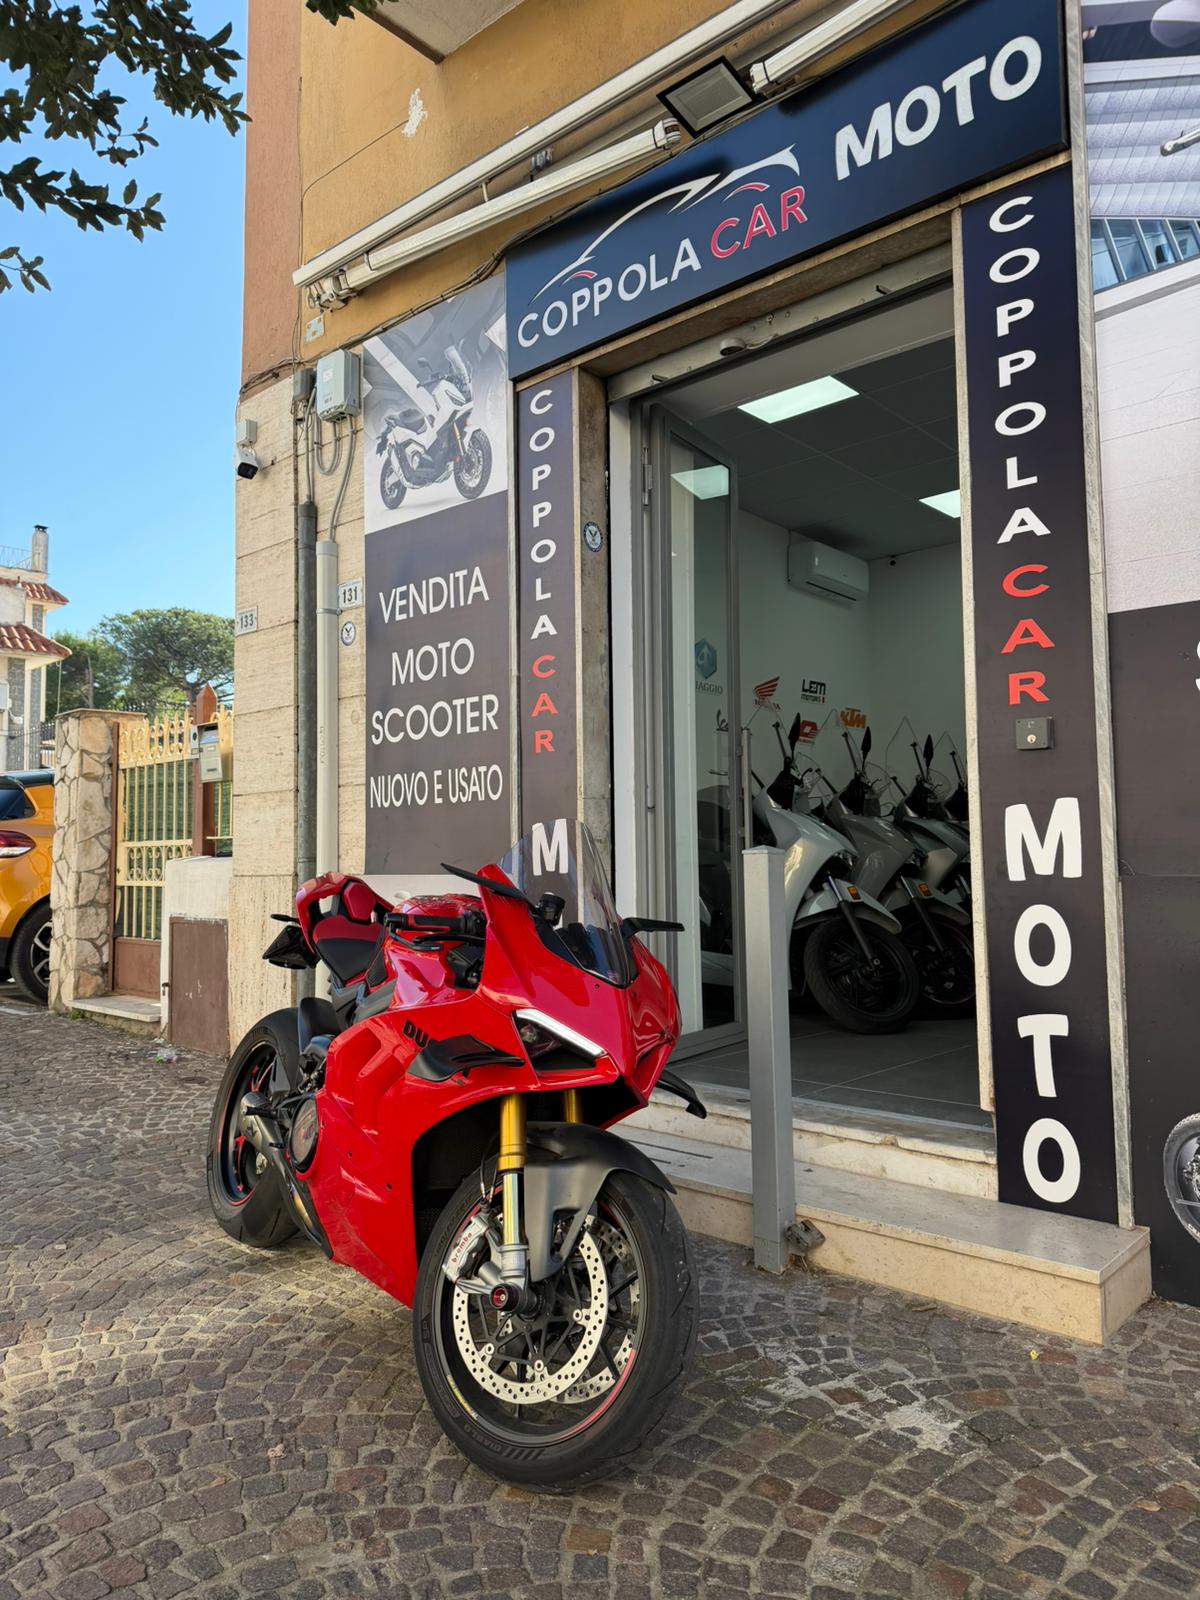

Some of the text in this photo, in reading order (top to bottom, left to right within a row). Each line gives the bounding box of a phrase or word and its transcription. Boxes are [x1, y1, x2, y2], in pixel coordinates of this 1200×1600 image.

[835, 35, 1042, 181] MOTO
[517, 184, 806, 349] COPPOLA CAR
[528, 389, 559, 641] COPPOLA
[342, 585, 359, 604] 131
[378, 565, 491, 624] VENDITA
[239, 613, 255, 630] 133
[391, 637, 476, 687] MOTO
[530, 655, 557, 754] CAR
[695, 680, 724, 695] IAGGIO
[801, 679, 827, 696] LEM
[989, 196, 1083, 1203] COPPOLA CAR MOTO
[371, 693, 500, 746] SCOOTER
[840, 707, 867, 728] KTM
[369, 763, 504, 809] NUOVO E USATO
[402, 1018, 429, 1049] DU
[451, 1232, 473, 1264] brembo
